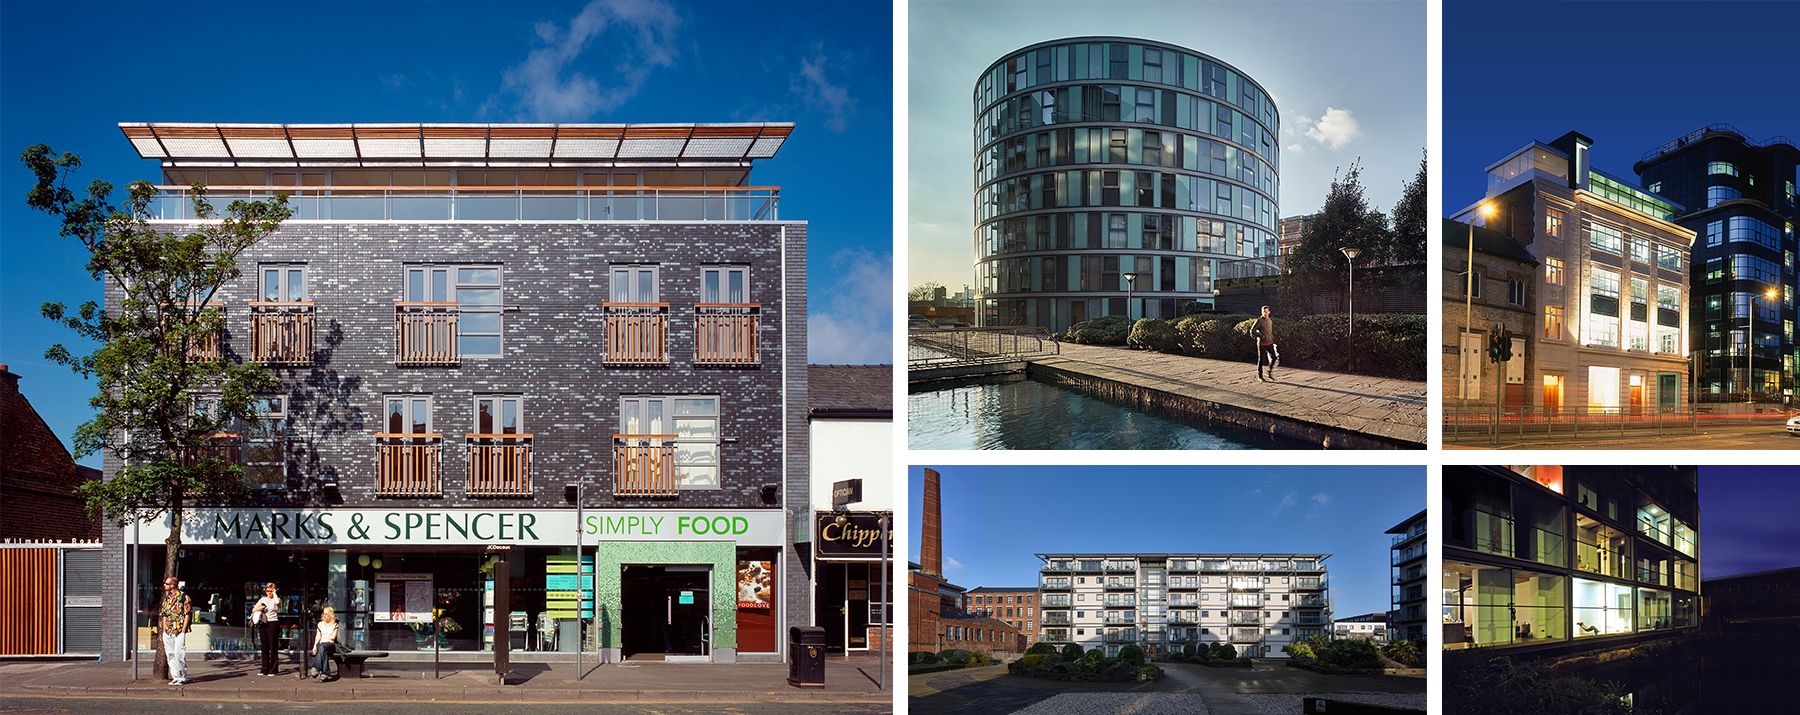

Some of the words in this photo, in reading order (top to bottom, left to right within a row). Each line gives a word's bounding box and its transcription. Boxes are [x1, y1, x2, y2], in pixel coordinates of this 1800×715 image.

[834, 487, 854, 498] OPTICIAN
[213, 512, 335, 540] MARKS
[347, 512, 371, 540] &
[384, 512, 540, 540] SPENCER
[586, 515, 665, 535] SIMPLY
[678, 516, 749, 535] FOOD
[822, 523, 893, 548] Chipp
